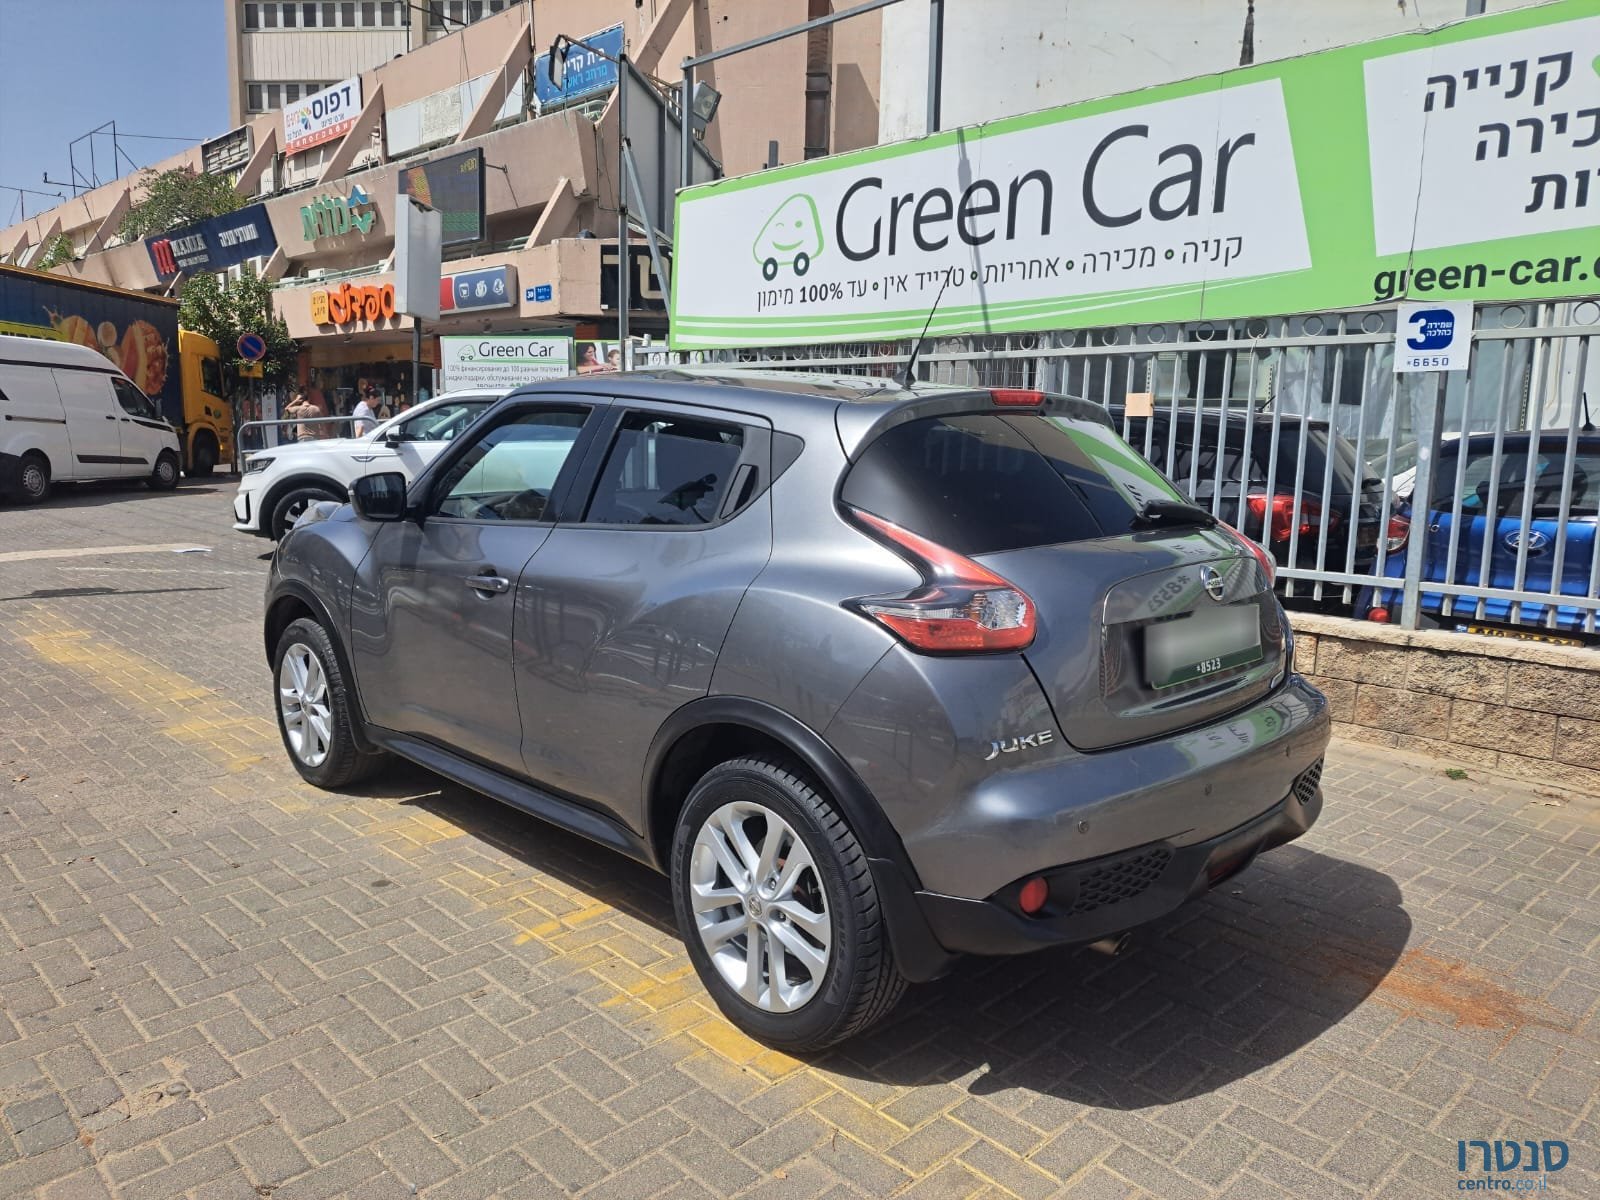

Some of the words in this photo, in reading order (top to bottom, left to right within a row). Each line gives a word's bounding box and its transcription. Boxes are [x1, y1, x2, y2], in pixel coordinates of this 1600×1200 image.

[1423, 51, 1573, 112] קנייה
[312, 86, 351, 120] דפוס
[835, 168, 1053, 262] Green
[1082, 124, 1256, 228] Car
[1082, 245, 1156, 274] מכירה
[1182, 236, 1243, 267] קניה
[914, 266, 965, 291] טרייד
[982, 255, 1060, 285] אחריות
[1373, 255, 1600, 301] green-car.
[757, 287, 794, 313] מימון
[799, 283, 843, 304] 100%
[847, 279, 868, 299] עד
[883, 273, 909, 300] אין
[1426, 329, 1452, 337] כהלכה
[1427, 321, 1453, 329] שמירה
[478, 342, 524, 357] Green
[528, 342, 555, 357] Car
[984, 729, 1054, 761] JUKE
